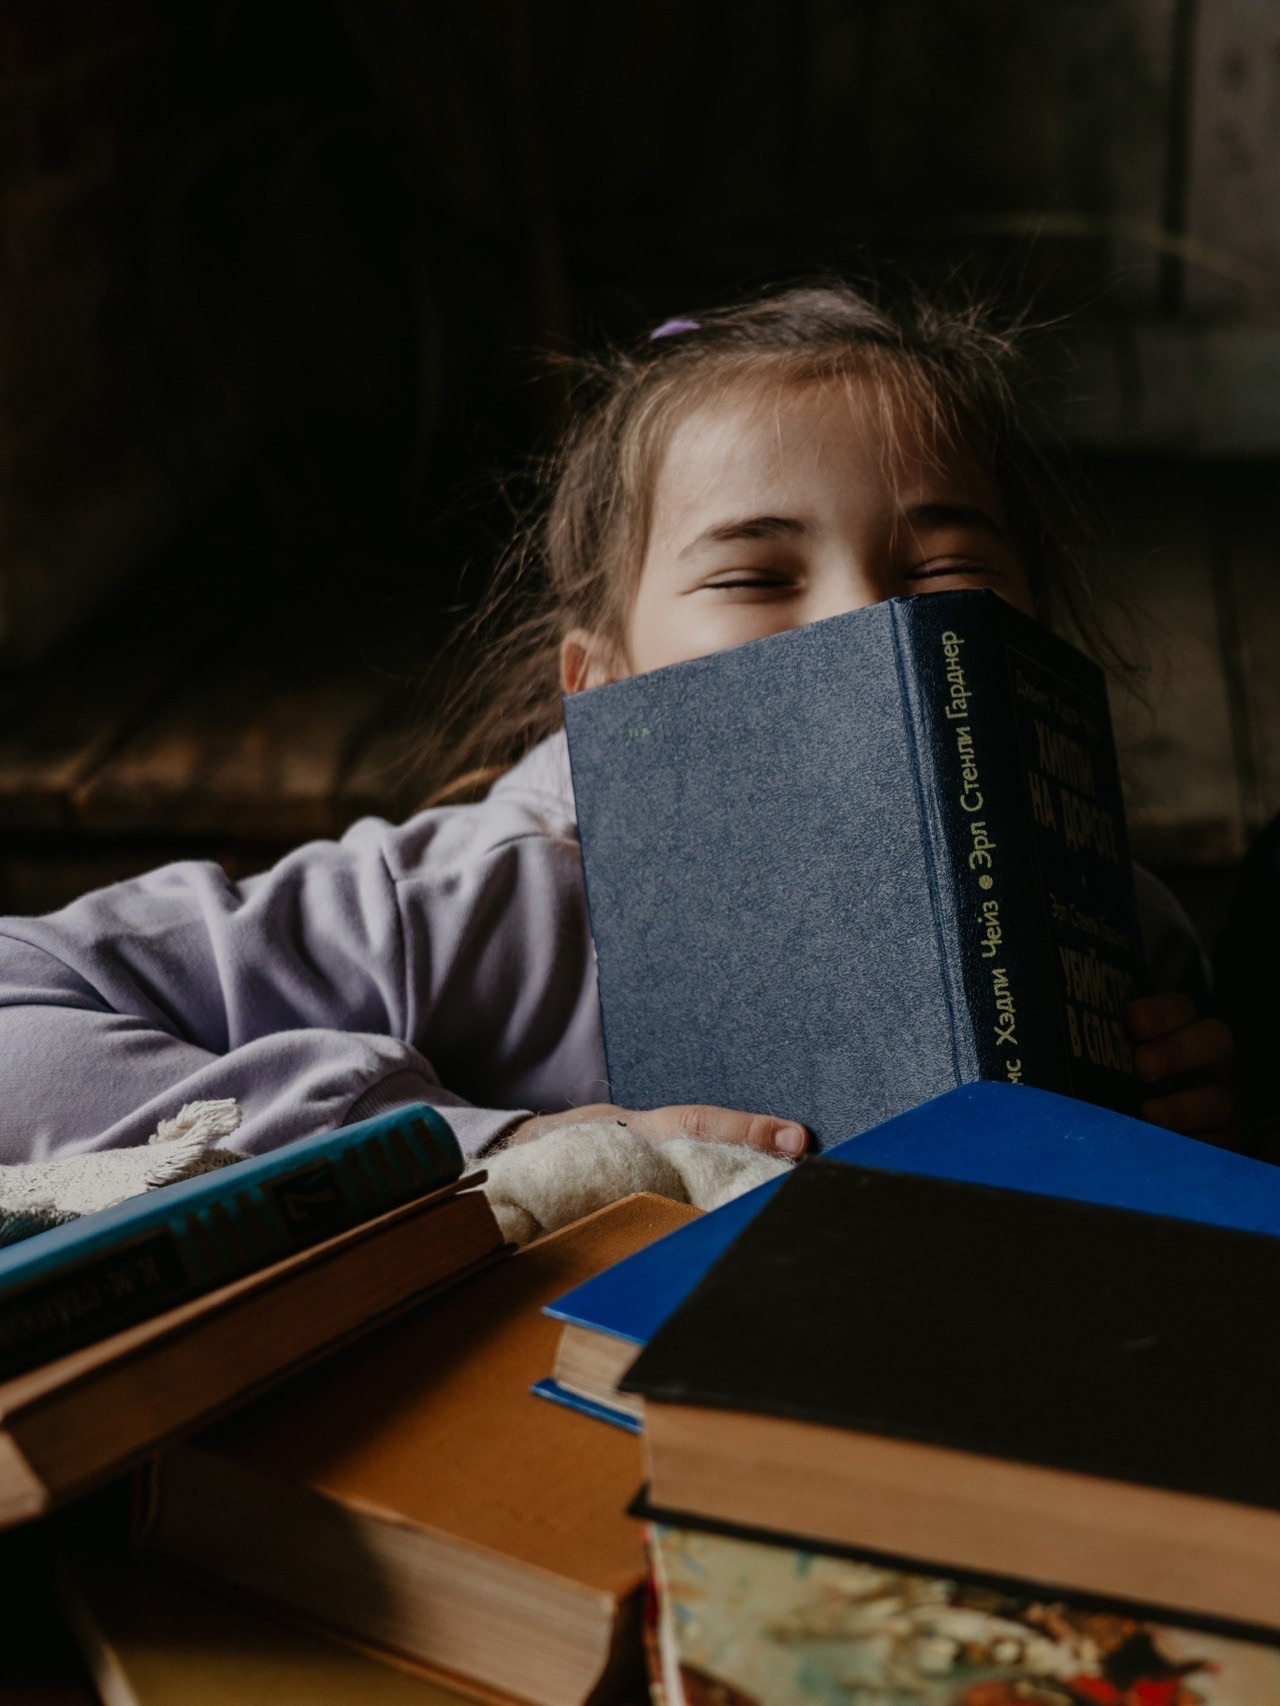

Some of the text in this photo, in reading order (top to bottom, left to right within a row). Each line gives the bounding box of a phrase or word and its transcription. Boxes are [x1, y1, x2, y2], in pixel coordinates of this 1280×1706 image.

[941, 630, 972, 720] Гарднер
[956, 726, 984, 812] Стенли
[1028, 769, 1058, 832] НА
[968, 821, 997, 870] Эрл
[977, 900, 1003, 958] Чейз
[991, 968, 1018, 1046] Хэдли
[1066, 1002, 1082, 1058] В
